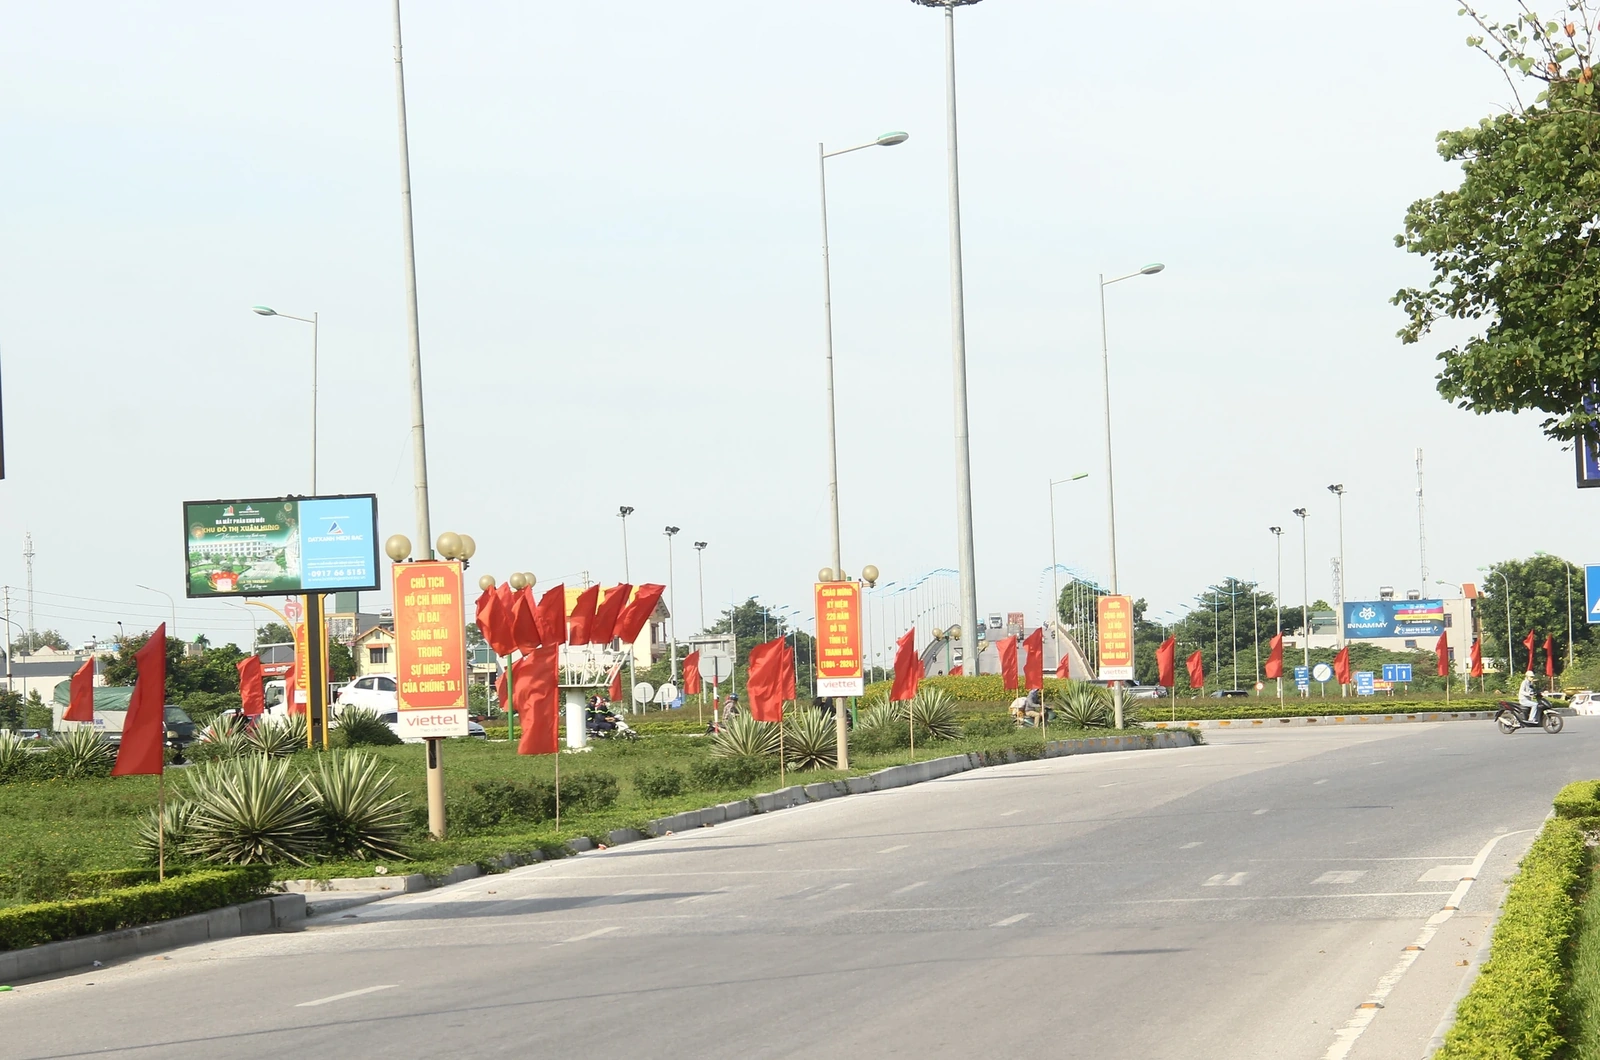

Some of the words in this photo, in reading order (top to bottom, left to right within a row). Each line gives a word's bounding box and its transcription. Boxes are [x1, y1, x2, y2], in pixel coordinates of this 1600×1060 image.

[410, 574, 426, 589] CHỦ
[428, 577, 444, 589] TỊCH
[405, 592, 415, 606] HỒ
[416, 592, 429, 606] CHÍ
[431, 594, 452, 605] MINH
[418, 610, 425, 623] VĨ
[427, 611, 440, 624] ĐẠI
[411, 628, 431, 641] SỐNG
[433, 627, 448, 639] MÃI
[417, 646, 442, 658] TRONG
[411, 664, 422, 678] SỰ
[423, 663, 451, 677] NGHIỆP
[402, 680, 418, 693] CỦA
[419, 680, 445, 693] CHÚNG
[446, 681, 455, 691] TA
[407, 714, 459, 726] viettel
